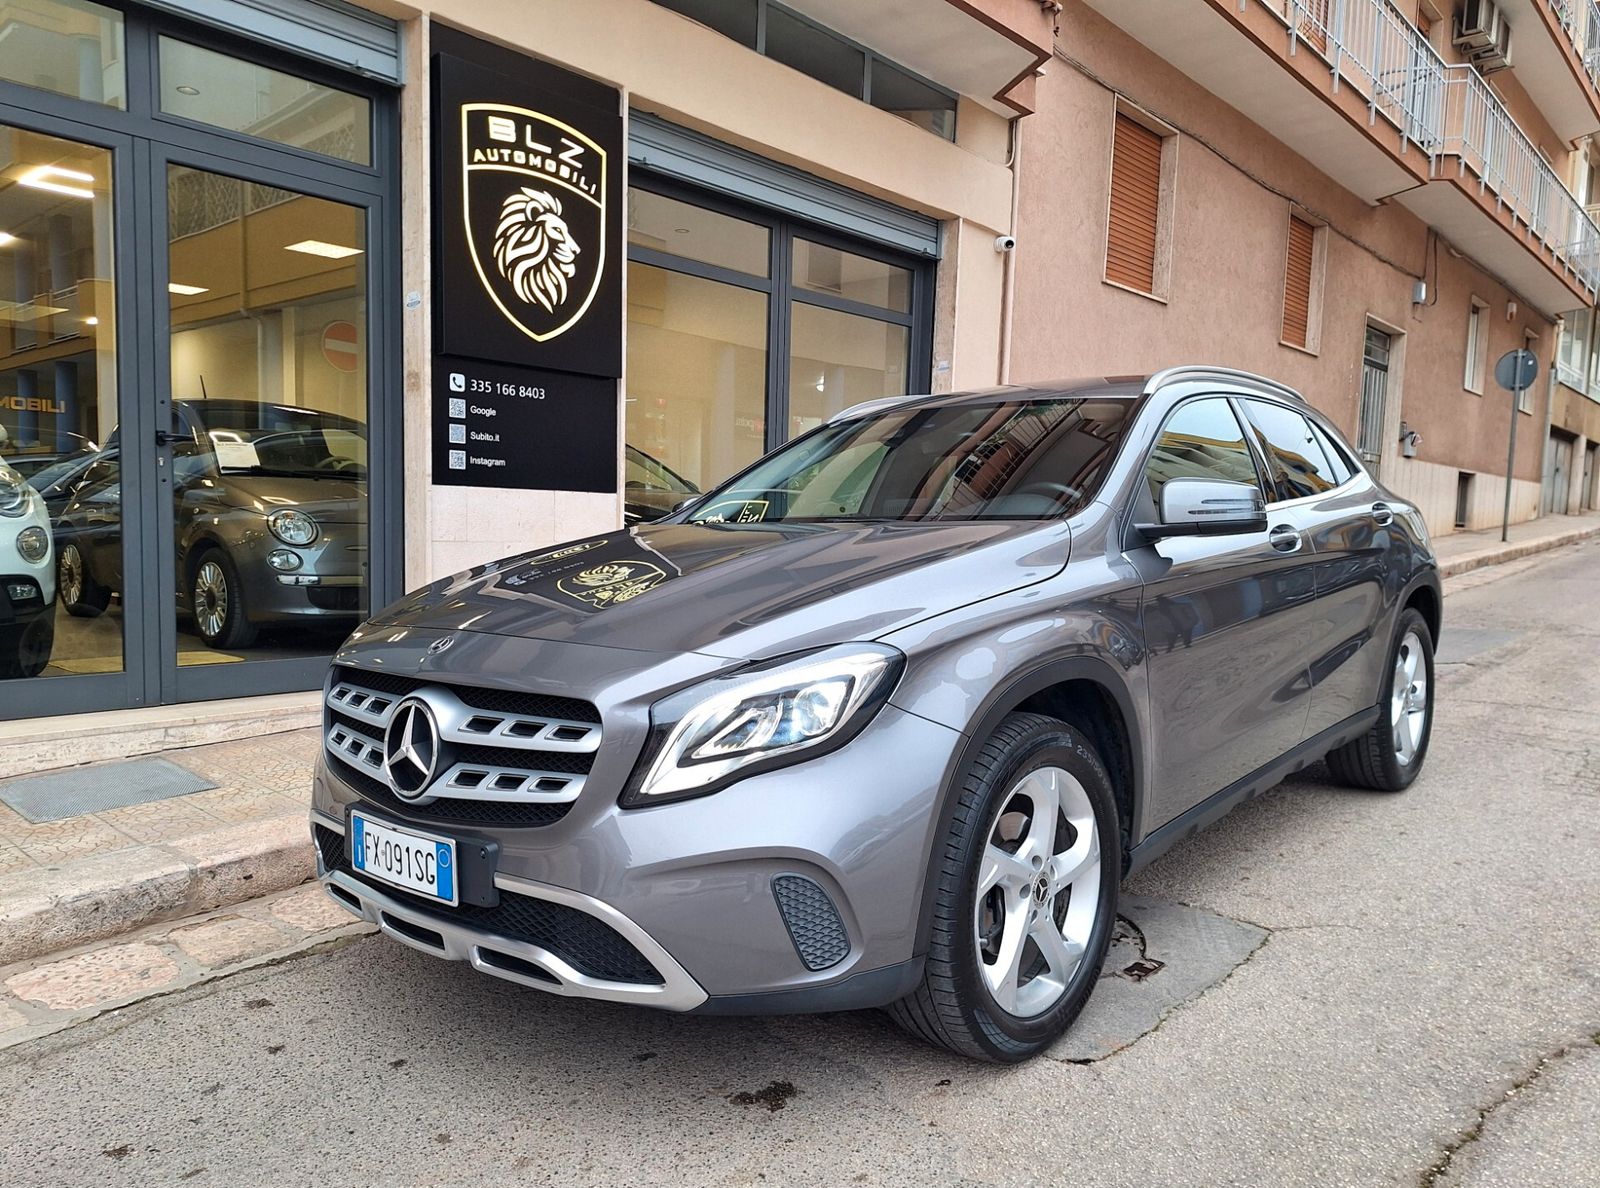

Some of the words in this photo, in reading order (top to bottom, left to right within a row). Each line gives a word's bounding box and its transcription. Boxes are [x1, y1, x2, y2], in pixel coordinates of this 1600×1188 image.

[488, 115, 585, 169] BLZ
[473, 148, 597, 195] AUTOMOBILI
[470, 379, 492, 393] 335
[496, 383, 516, 396] 166
[518, 386, 545, 400] 8403
[470, 405, 497, 417] Google
[470, 431, 500, 442] Subito.it
[469, 456, 506, 467] Instagram
